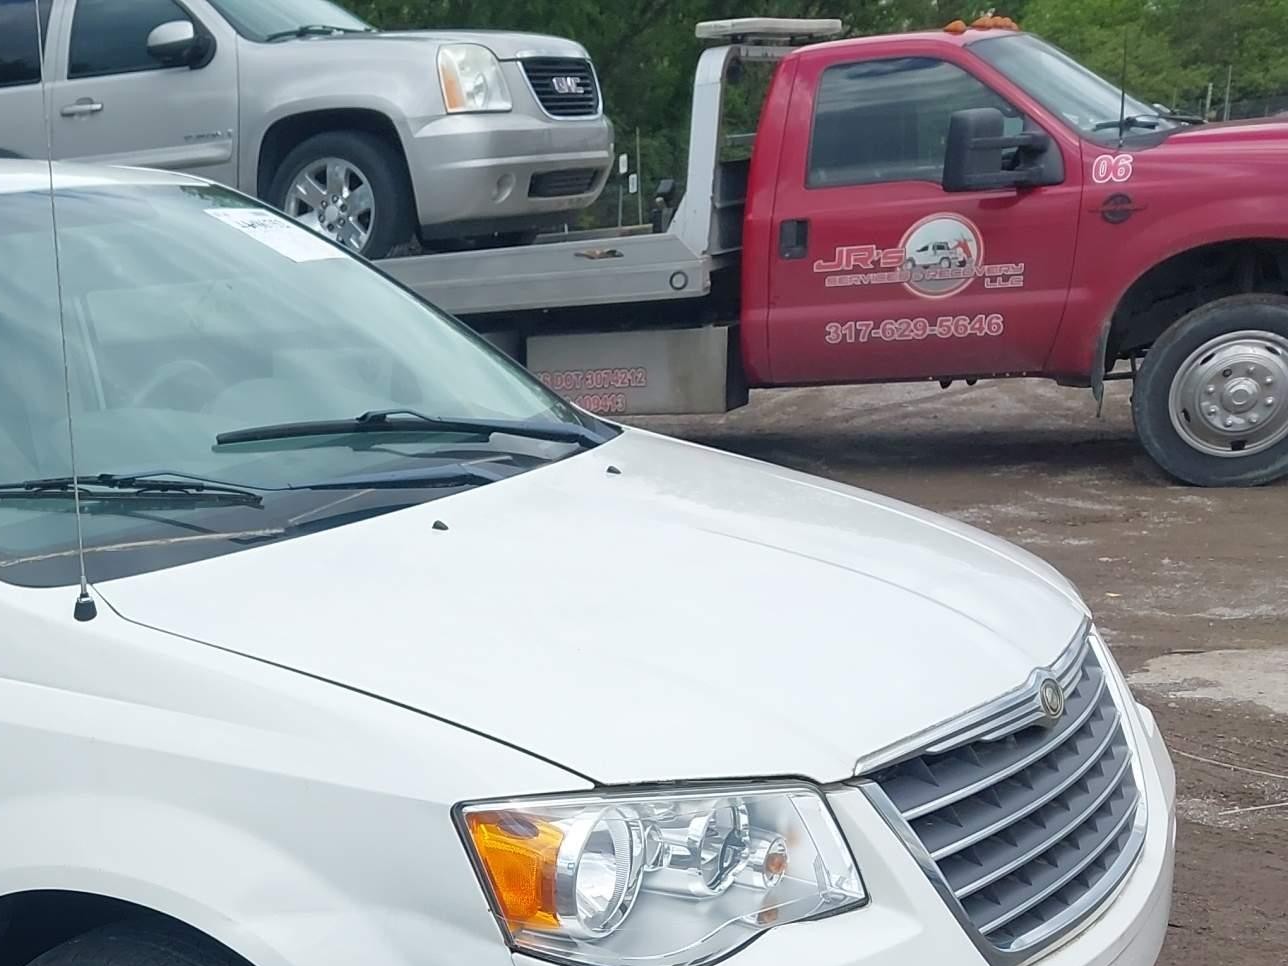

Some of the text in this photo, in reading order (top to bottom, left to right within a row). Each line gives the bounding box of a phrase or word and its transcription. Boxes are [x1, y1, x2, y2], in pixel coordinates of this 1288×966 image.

[1092, 154, 1133, 183] 06
[926, 263, 1024, 282] RECOVERY
[985, 276, 1024, 289] LLC
[825, 313, 1004, 344] 317-629-5646
[552, 370, 583, 390] DOT
